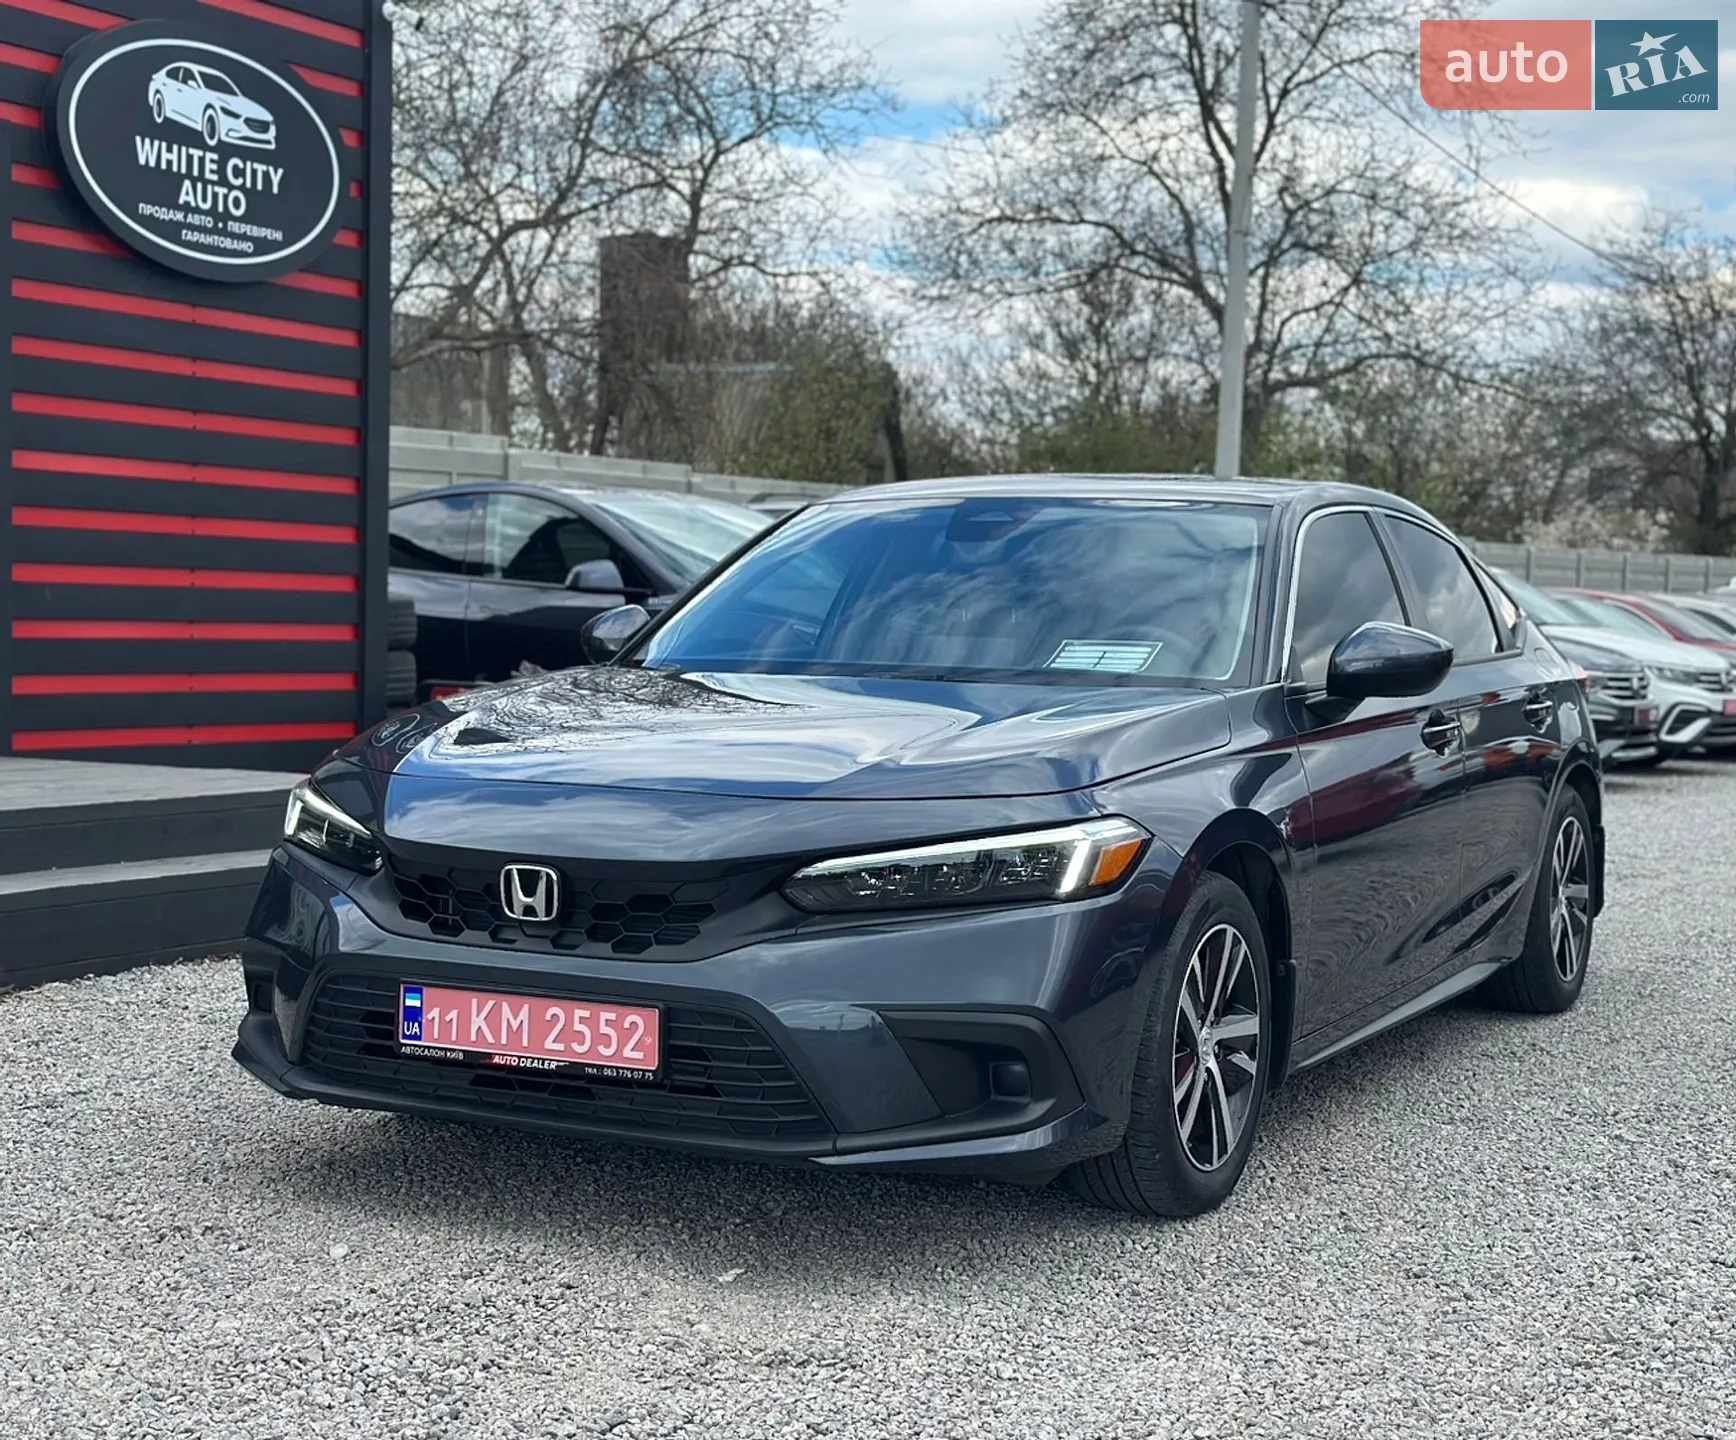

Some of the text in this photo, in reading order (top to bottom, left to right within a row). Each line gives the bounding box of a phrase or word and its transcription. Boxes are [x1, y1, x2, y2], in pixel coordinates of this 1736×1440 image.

[135, 135, 284, 194] WHITE CITY
[178, 178, 247, 217] AUTO
[138, 203, 283, 241] ПРОДАЖ АВТО ПЕРЕВІРЕНІ
[181, 229, 254, 253] ГАРАНТОВАНО
[404, 1022, 420, 1035] UA
[427, 998, 645, 1060] 11 KM 2552
[401, 1046, 445, 1058] АВТОСАЛОН
[492, 1055, 557, 1070] AUTO DEALER
